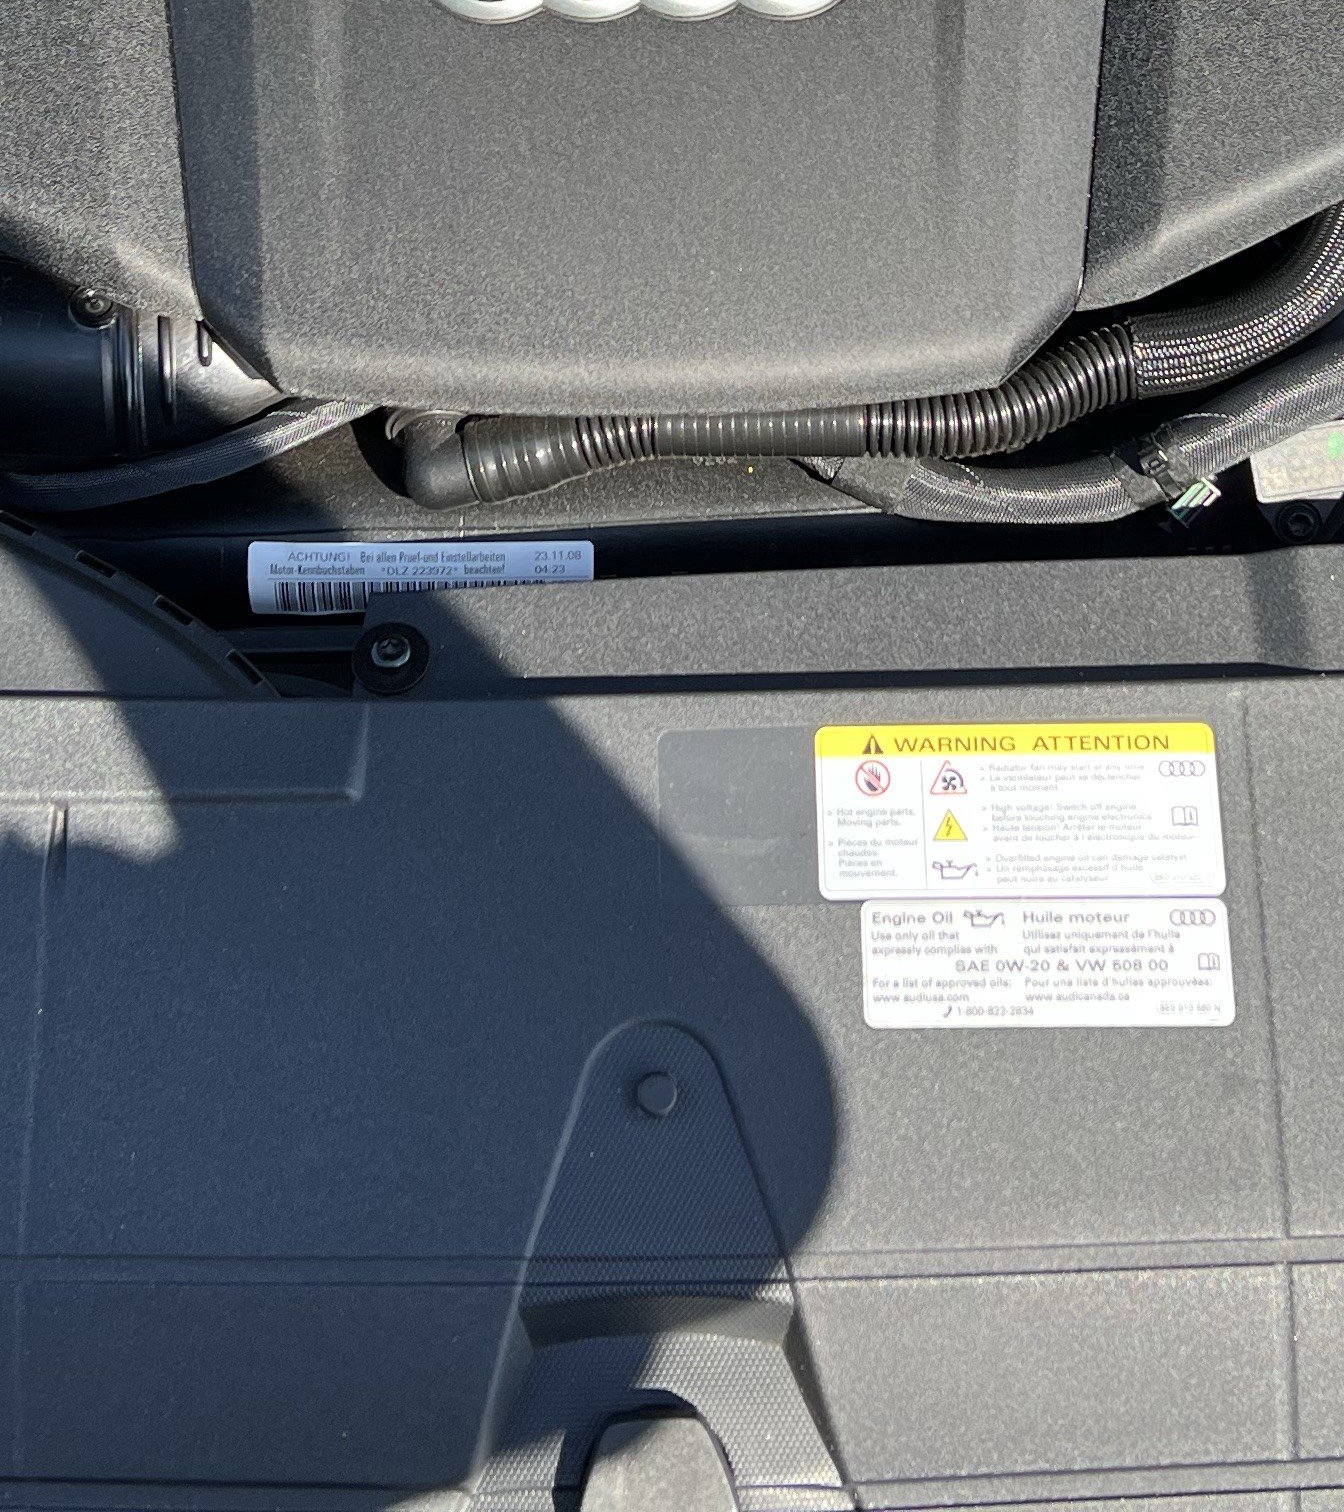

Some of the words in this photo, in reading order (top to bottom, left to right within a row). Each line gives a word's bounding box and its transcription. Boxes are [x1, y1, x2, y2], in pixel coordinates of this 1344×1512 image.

[894, 737, 1016, 752] WARNING
[1032, 735, 1170, 751] ATTENTION
[856, 809, 887, 818] engine
[872, 912, 926, 926] Engine
[932, 911, 953, 923] Oil
[1023, 911, 1063, 923] Huile
[1069, 911, 1130, 923] moteur
[871, 931, 892, 940] Use
[895, 930, 918, 942] only
[922, 930, 935, 940] oil
[939, 930, 959, 940] that
[1023, 929, 1061, 939] Utilisez
[1065, 929, 1129, 942] uniquement
[1132, 929, 1144, 939] de
[872, 945, 921, 956] expressly
[924, 945, 971, 957] complies
[974, 944, 997, 954] with
[1024, 944, 1040, 954] qui
[1044, 943, 1085, 954] satisfait
[955, 959, 989, 972] SAE
[995, 959, 1050, 972] 0W-20
[1056, 959, 1069, 971] &
[1076, 959, 1105, 971] VW
[1148, 958, 1168, 971] 00
[873, 977, 889, 987] For
[894, 979, 899, 987] a
[903, 977, 917, 987] list
[922, 977, 933, 987] of
[936, 977, 986, 989] approved
[1025, 977, 1049, 987] Pour
[1053, 978, 1072, 986] une
[1076, 977, 1098, 986] liste
